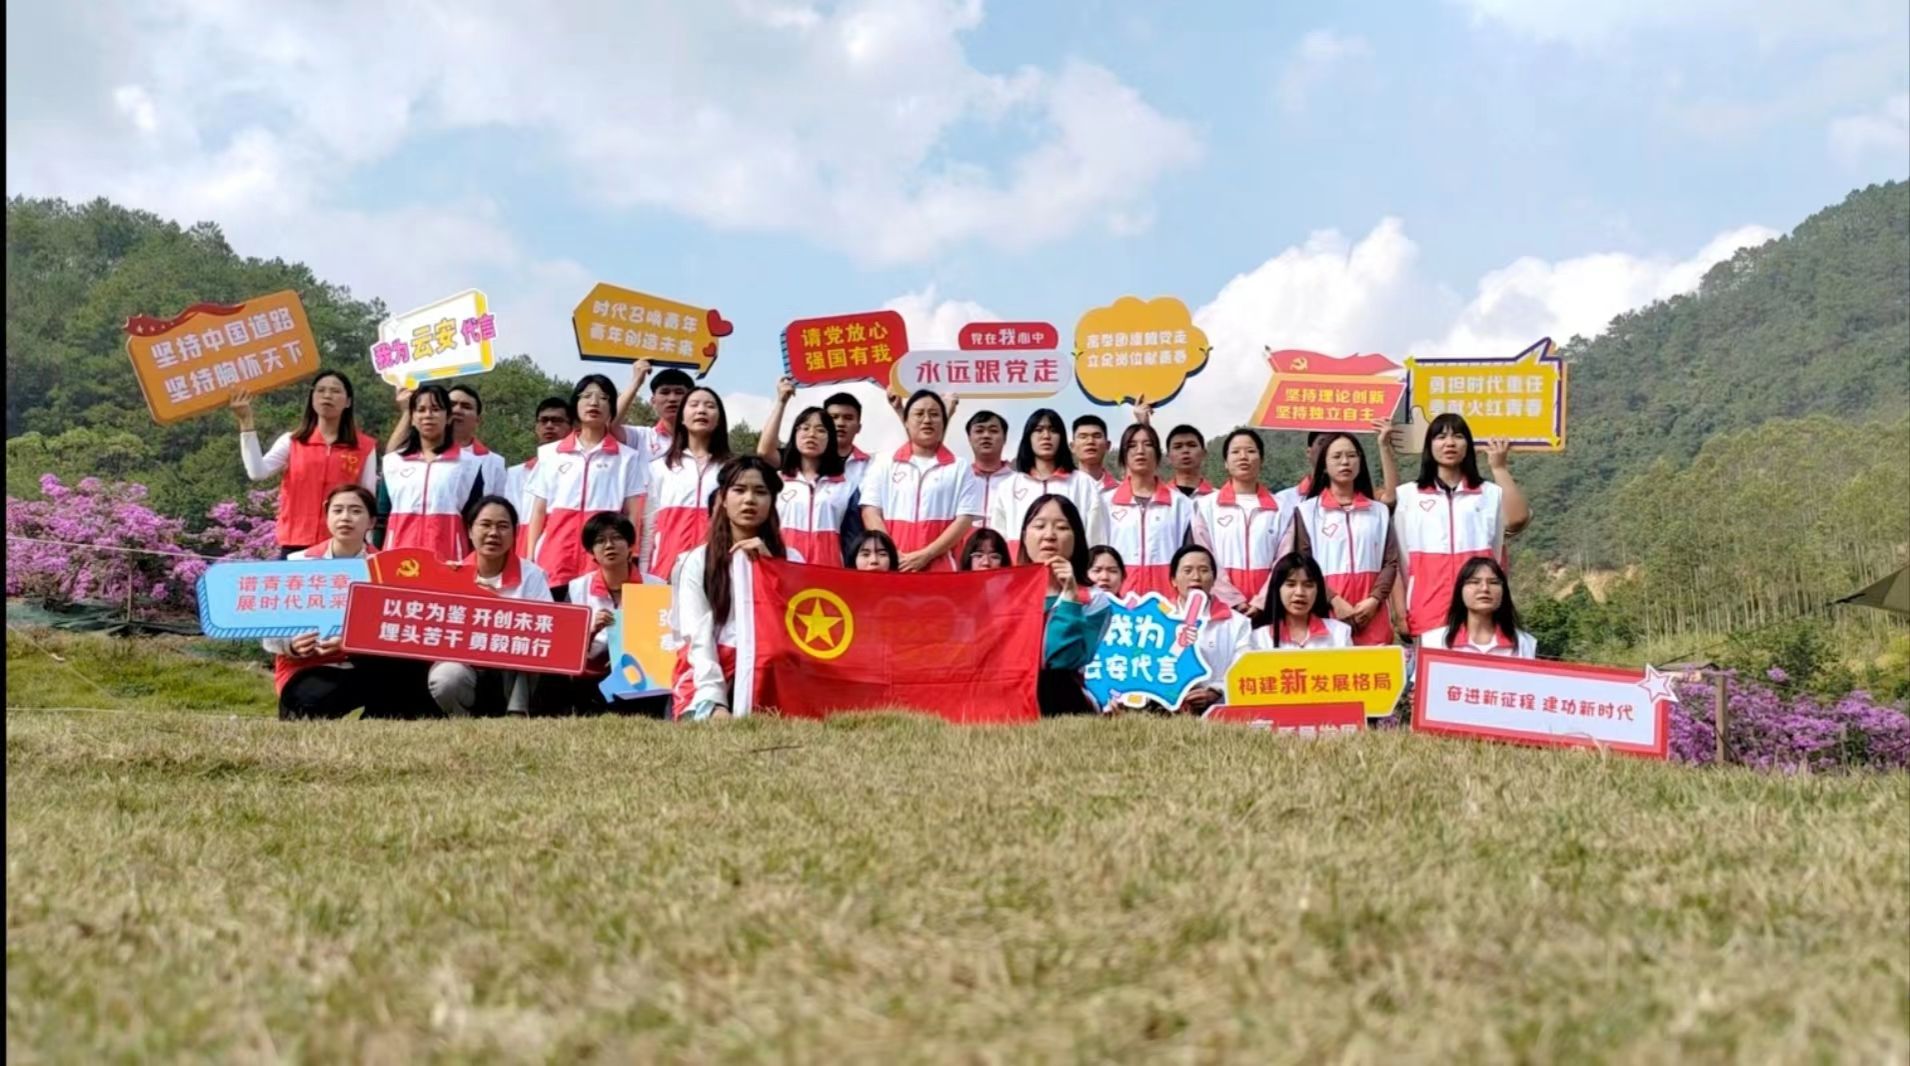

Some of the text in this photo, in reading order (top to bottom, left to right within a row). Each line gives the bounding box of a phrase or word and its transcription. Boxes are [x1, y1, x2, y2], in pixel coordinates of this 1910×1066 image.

[150, 307, 296, 369] 坚持中国道路
[373, 314, 497, 370] 我为云安代言
[802, 321, 889, 348] 请党放心
[806, 343, 893, 371] 强国有我
[165, 340, 304, 404] 坚持胸怀天下
[916, 359, 1059, 384] 永远跟党走
[1429, 376, 1544, 394] 勇担时代重任
[1285, 388, 1385, 405] 坚持理论创新
[1276, 406, 1375, 422] 坚持独立自主
[238, 574, 350, 591] 谱青春华章
[236, 594, 347, 611] 展时代风采
[383, 599, 554, 633] 以史为鉴 开创未来
[378, 621, 552, 658] 埋头苦干 勇毅前行
[1104, 613, 1165, 649] 我为
[1239, 668, 1392, 695] 构建新发展格局
[1446, 685, 1635, 722] 奋进新征程 建功新时代
